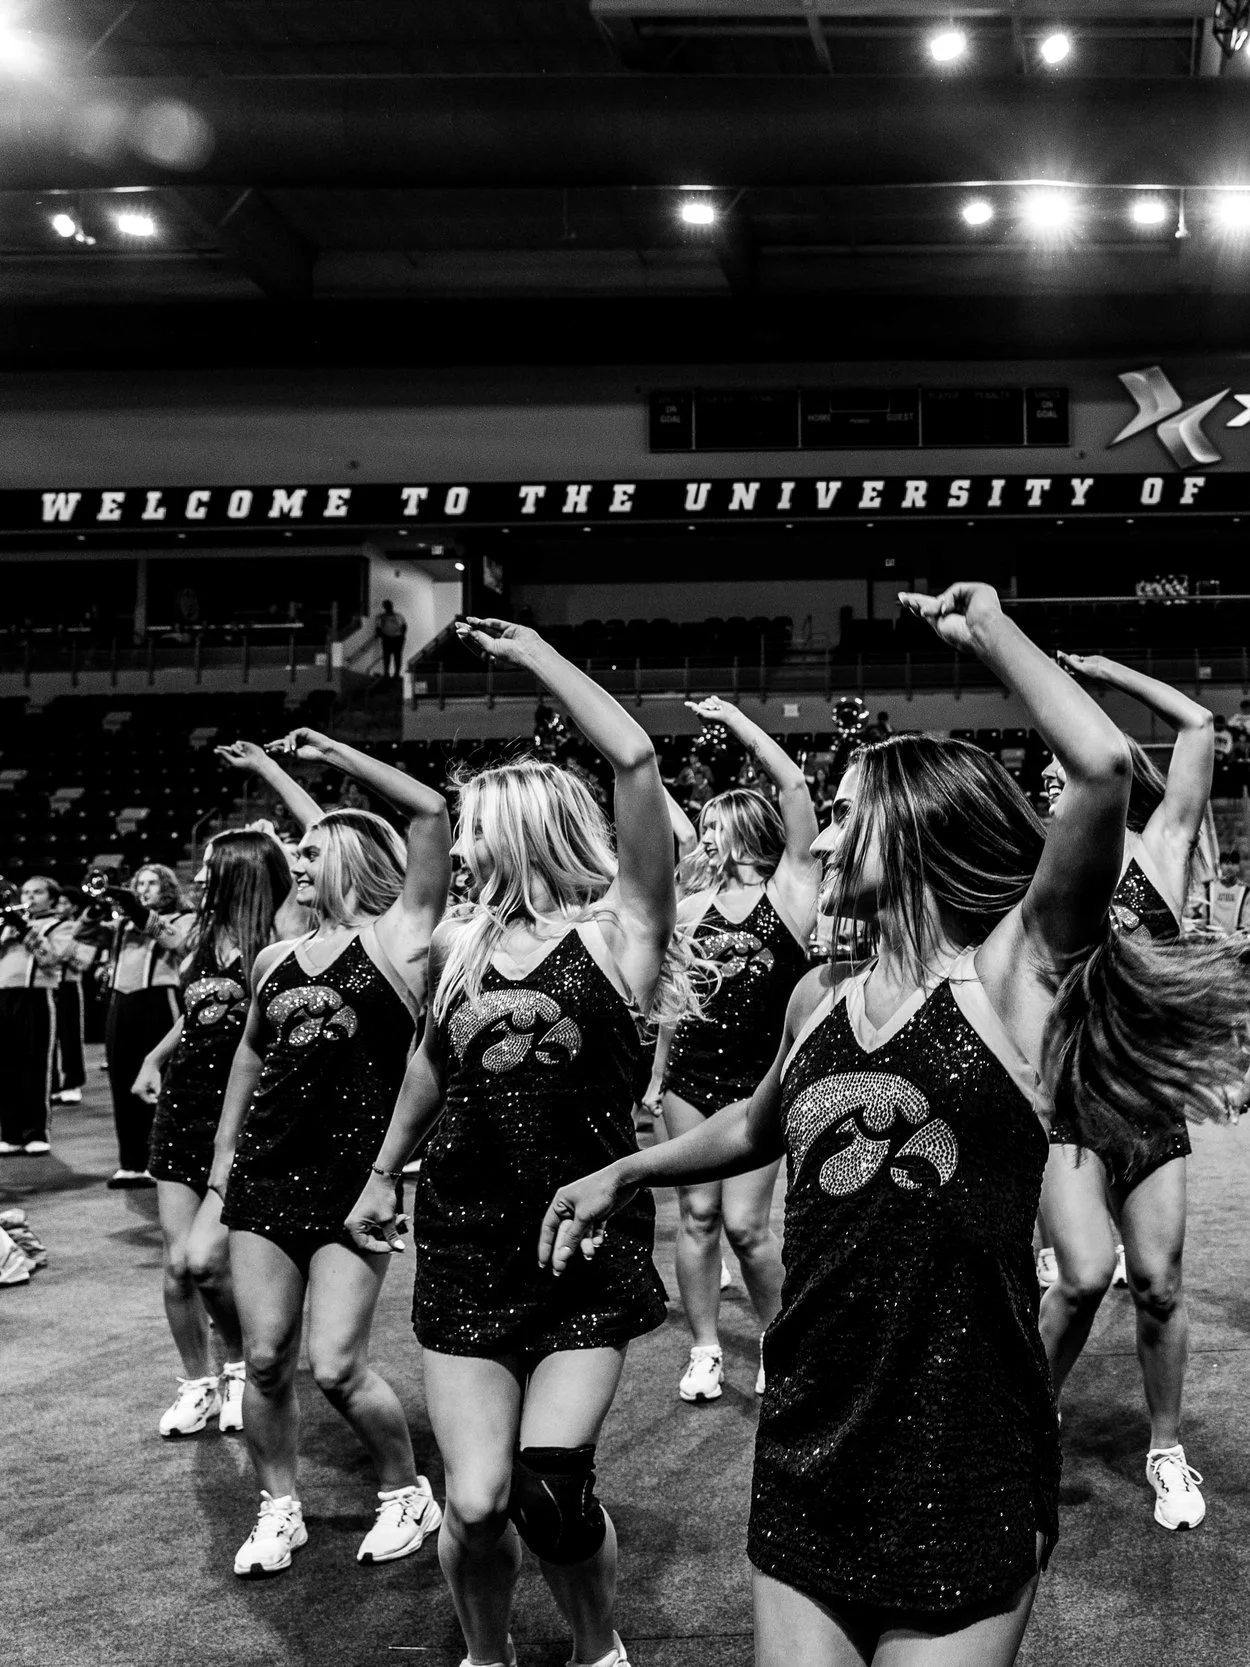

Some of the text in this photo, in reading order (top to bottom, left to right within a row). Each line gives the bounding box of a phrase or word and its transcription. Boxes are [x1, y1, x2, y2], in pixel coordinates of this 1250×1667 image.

[41, 488, 352, 522] WELCOME
[400, 487, 470, 516] TO
[518, 484, 636, 514] THE
[684, 478, 1094, 511] UNIVERSITY
[1140, 477, 1206, 505] OF
